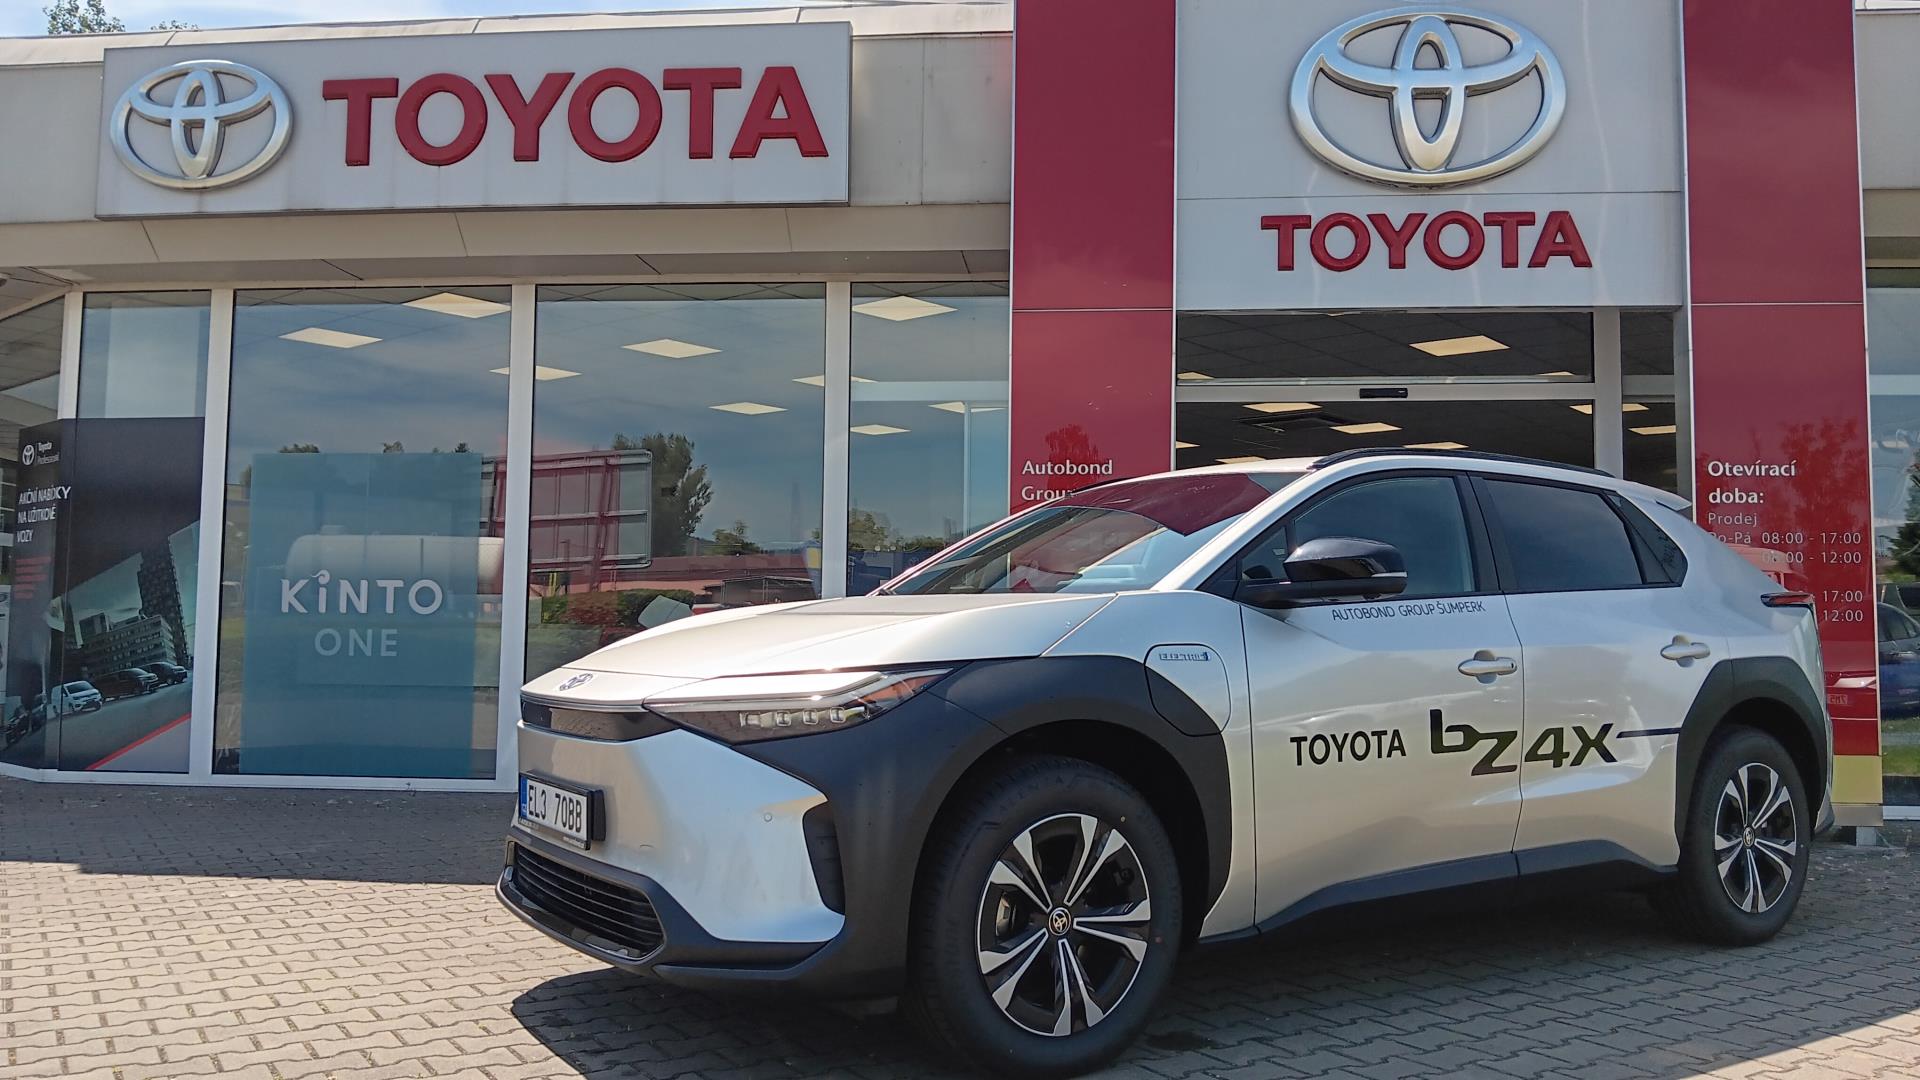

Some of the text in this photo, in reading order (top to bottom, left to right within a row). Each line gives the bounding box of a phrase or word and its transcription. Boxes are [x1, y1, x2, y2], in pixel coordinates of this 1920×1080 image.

[322, 66, 829, 167] TOYOTA
[1260, 210, 1593, 272] TOYOTA
[1022, 460, 1113, 475] Autobond
[1707, 460, 1797, 477] Otevírací
[1021, 485, 1073, 502] Grou
[1708, 487, 1764, 504] doba:
[1708, 513, 1758, 527] Prodej
[1761, 532, 1804, 544] 08:00
[1820, 532, 1862, 544] 17:00
[1821, 551, 1862, 563] 12:00
[1822, 590, 1863, 602] 17:00
[1331, 600, 1487, 621] AUTOBOND GROUP ŠUMPERK
[1823, 609, 1864, 622] 12:00
[314, 628, 398, 656] ONE
[1289, 729, 1407, 766] TOYOTA
[528, 784, 547, 820] EL3
